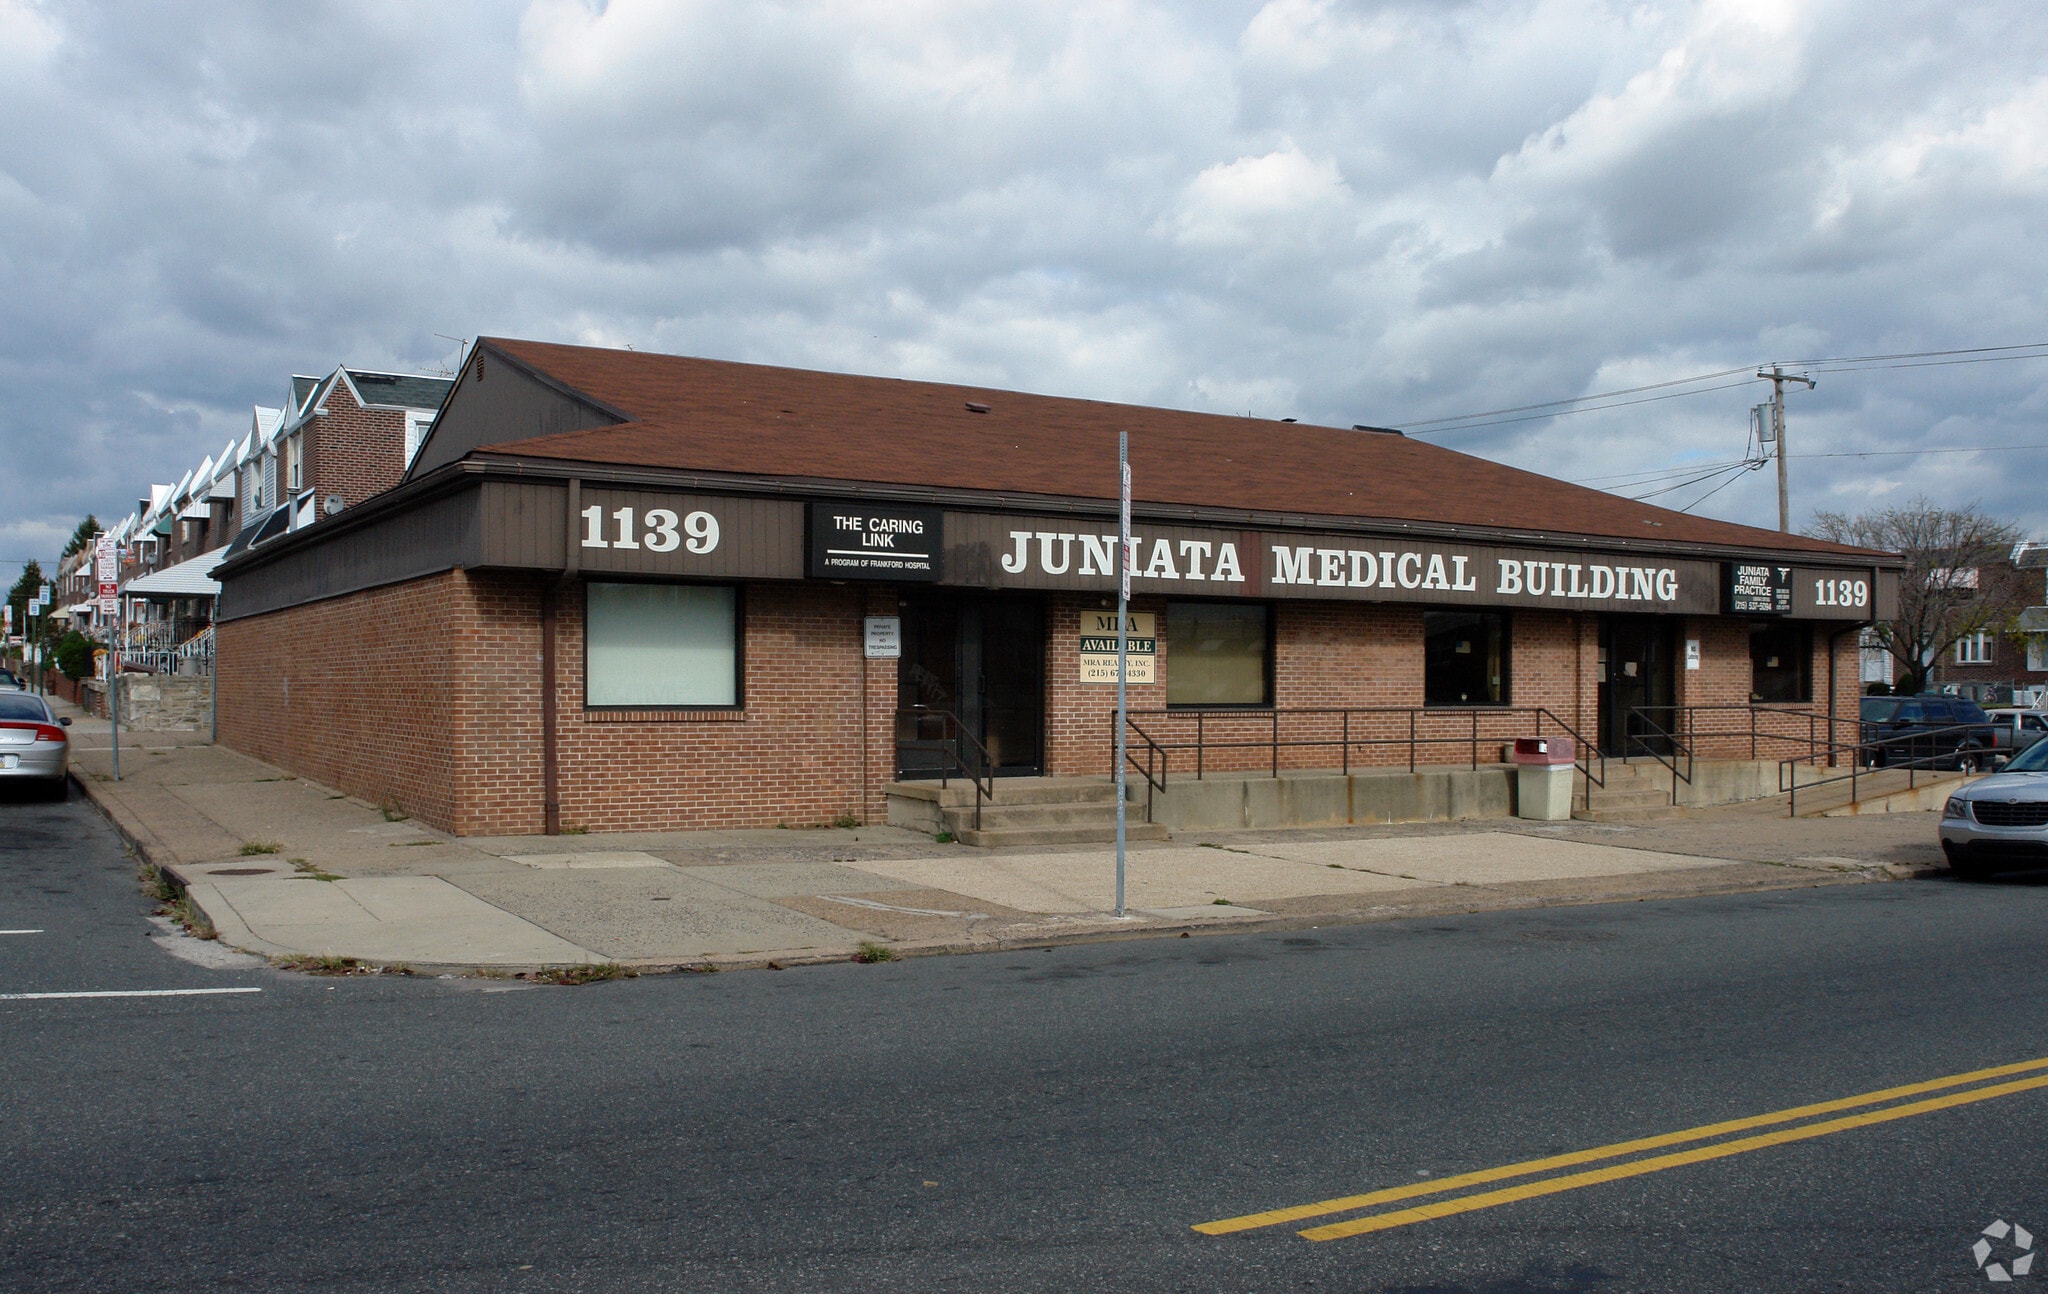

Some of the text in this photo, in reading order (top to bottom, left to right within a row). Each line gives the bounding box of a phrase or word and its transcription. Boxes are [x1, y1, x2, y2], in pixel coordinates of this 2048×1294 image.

[581, 505, 720, 554] 1139
[833, 515, 924, 534] THE CARING
[862, 532, 895, 548] LINK
[824, 558, 931, 570] A PROGRAM OF FRANKFORD HOSPITAL
[1001, 531, 1246, 582] JUNIATA
[1271, 545, 1476, 592] MEDICAL
[1497, 558, 1679, 601] BUILDING
[1736, 565, 1770, 577] JUNIATA
[1739, 575, 1768, 586] FAMILY
[1734, 584, 1772, 597] PRACTICE
[1815, 579, 1868, 608] 1139
[1082, 639, 1152, 652] AVAILBLE
[1083, 658, 1101, 667] MRA
[1135, 660, 1151, 668] INC.
[1088, 669, 1109, 678] (215)
